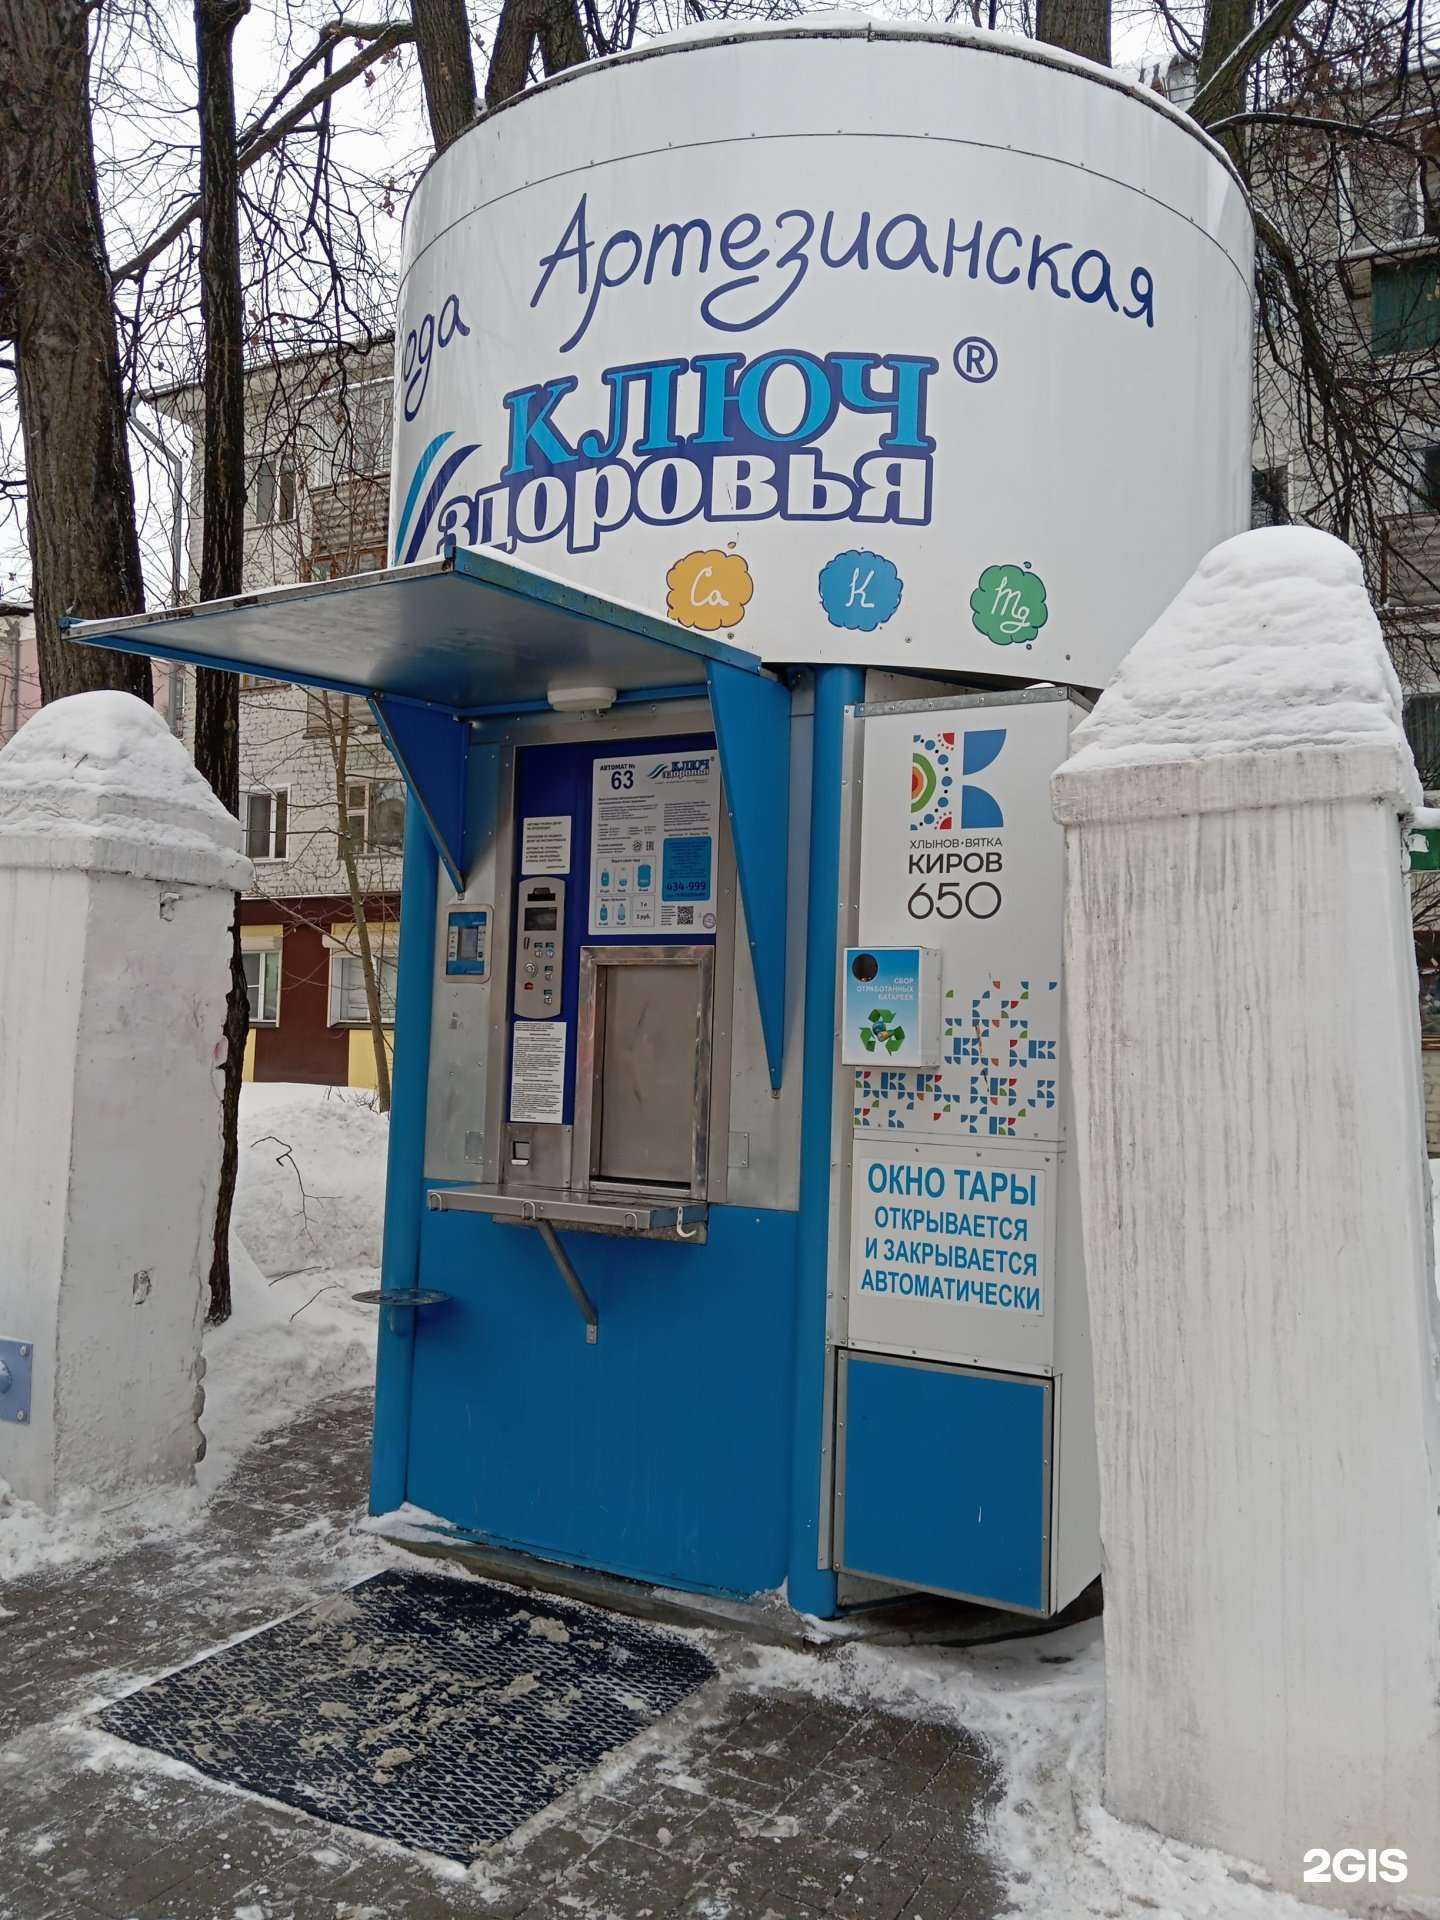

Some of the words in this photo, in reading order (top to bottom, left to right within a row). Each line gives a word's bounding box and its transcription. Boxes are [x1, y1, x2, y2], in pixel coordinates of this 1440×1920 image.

[530, 192, 1155, 353] Артезианская
[402, 294, 471, 422] ода
[611, 770, 634, 790] 63
[908, 852, 1003, 874] КИРОВ
[907, 881, 1002, 919] 650
[867, 1163, 945, 1198] ОКНО
[954, 1169, 1036, 1206] ТАРЫ
[875, 1206, 1028, 1242] ОТКРЫВАЕТСЯ
[865, 1237, 878, 1260] И
[884, 1239, 1037, 1277] ЗАКРЫВАЕТСЯ
[861, 1269, 1040, 1311] АВТОМАТИЧЕСКИ
